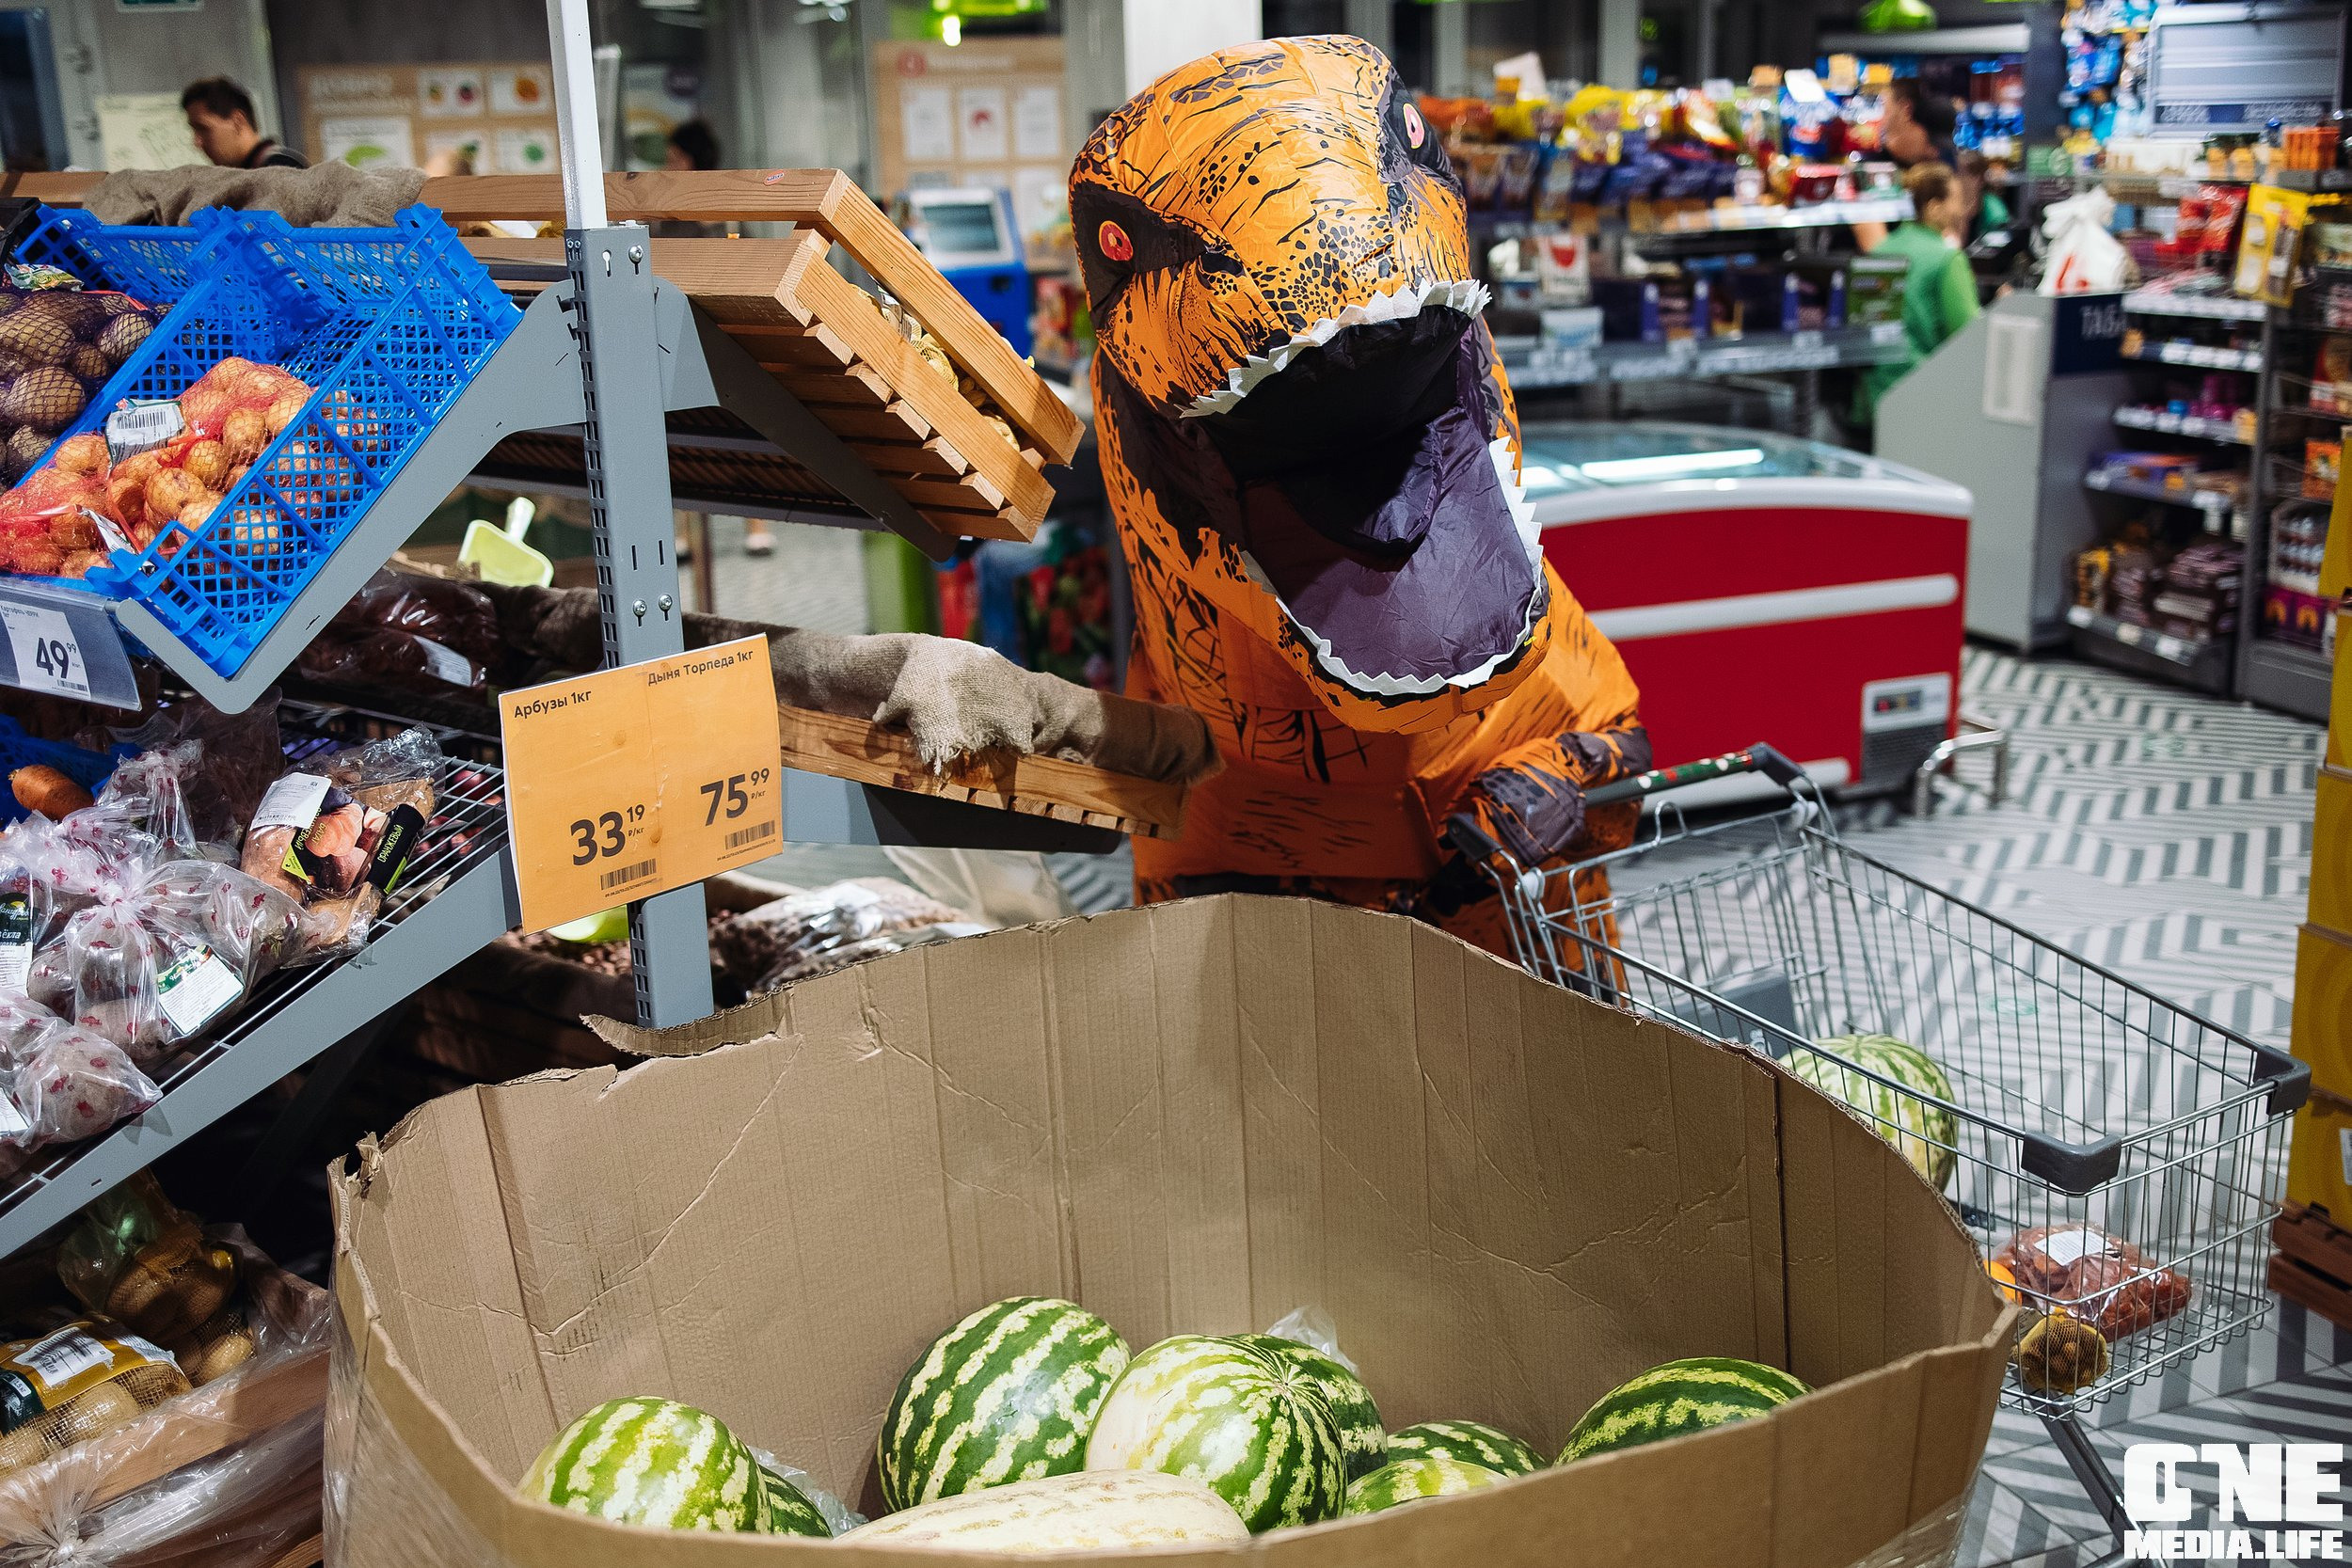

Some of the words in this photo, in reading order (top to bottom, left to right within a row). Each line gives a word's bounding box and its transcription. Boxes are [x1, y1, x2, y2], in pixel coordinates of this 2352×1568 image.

[37, 637, 69, 679] 49
[66, 641, 77, 654] 99
[647, 669, 680, 686] Дыня
[683, 656, 735, 674] Торпеда
[737, 651, 754, 662] 1кг
[514, 696, 568, 719] Арбузы
[570, 690, 592, 705] 1кг
[700, 773, 748, 827] 75
[751, 768, 770, 785] 99
[377, 824, 404, 863] ОРАНЖЕВЫЙ
[570, 811, 626, 865] 33
[627, 804, 645, 822] 19
